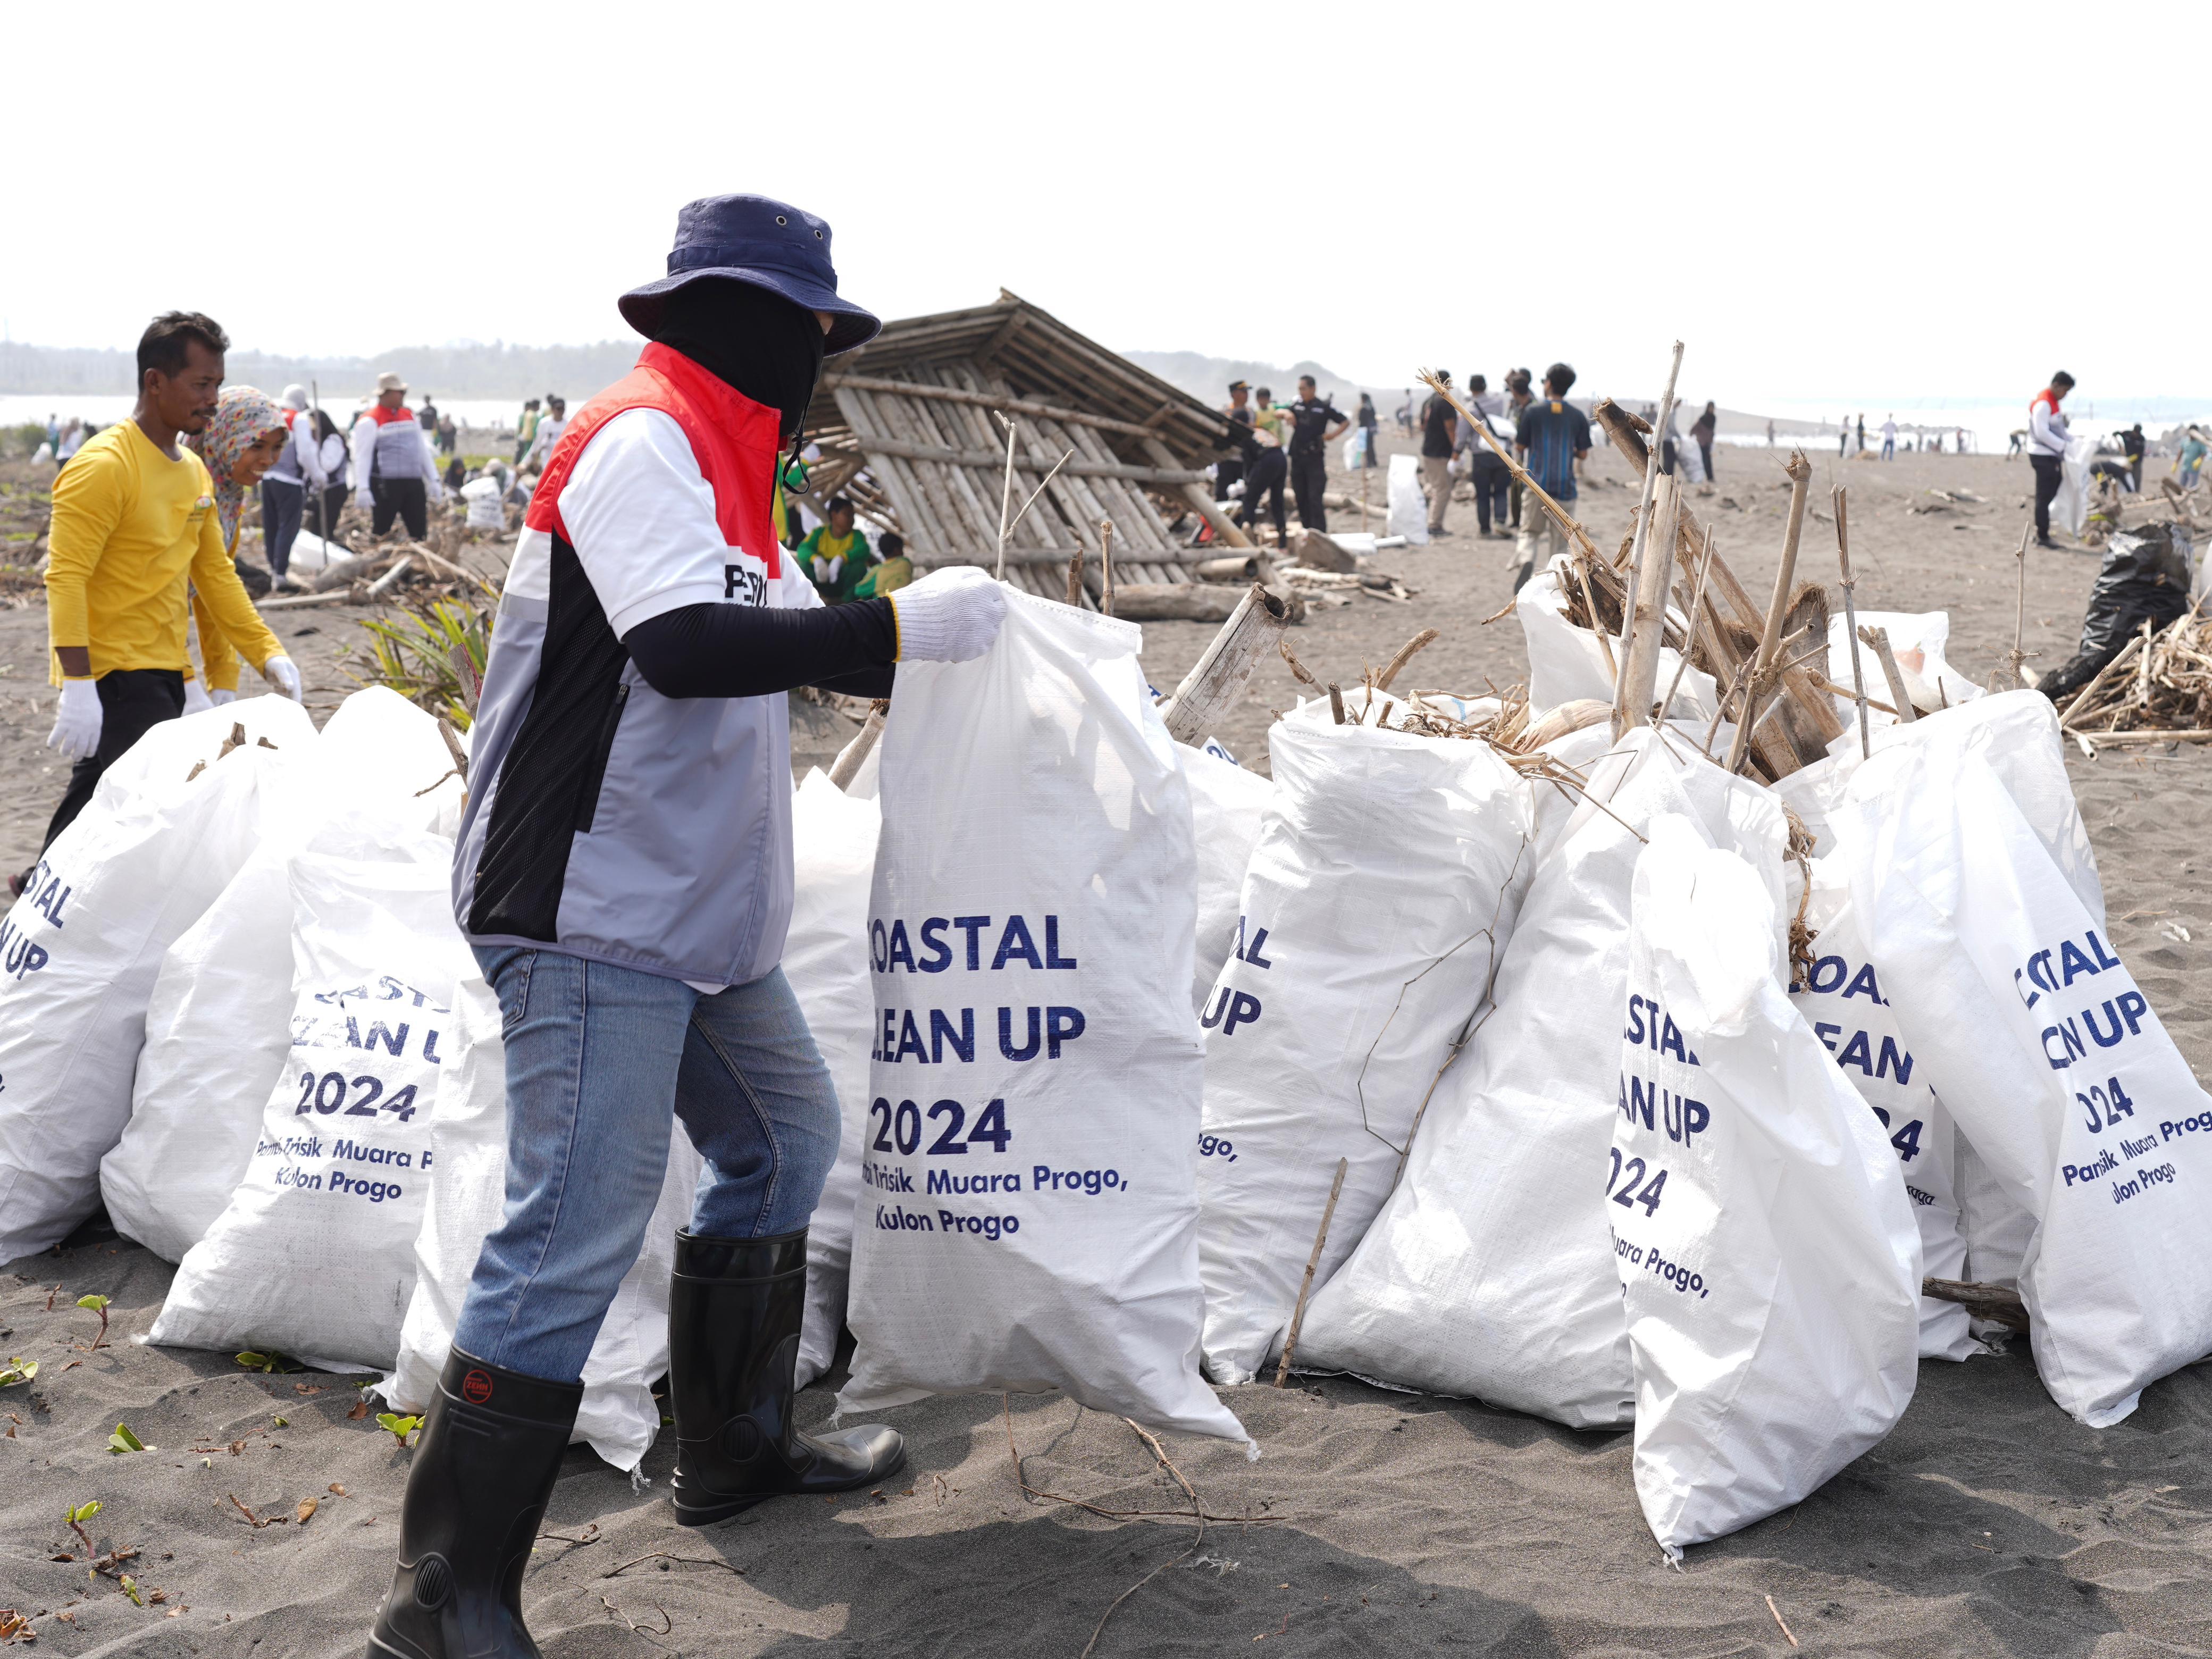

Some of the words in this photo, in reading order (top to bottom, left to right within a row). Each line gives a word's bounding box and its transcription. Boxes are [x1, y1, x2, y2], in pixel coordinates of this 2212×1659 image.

[6, 932, 48, 981] UP
[867, 915, 1077, 974] OASTAL
[872, 1007, 975, 1064] LEAN
[998, 1006, 1086, 1062] UP
[1201, 984, 1262, 1036] UP
[1624, 993, 1701, 1066] STA
[2081, 991, 2147, 1048] UP
[295, 1071, 418, 1122] 2024
[1663, 1088, 1710, 1148] UP
[870, 1096, 1011, 1156] 2024
[2119, 1134, 2159, 1161] Muara
[283, 1136, 323, 1158] Trisik
[332, 1139, 412, 1168] Muara
[2137, 1162, 2176, 1189] Progo
[274, 1166, 322, 1190] Kulon
[328, 1170, 403, 1203] Progo
[873, 1163, 916, 1193] Trisik
[927, 1169, 1021, 1195] Muara
[1033, 1164, 1128, 1196] Progo,
[876, 1204, 934, 1232] Kulon
[937, 1210, 1019, 1242] Progo
[1644, 1247, 1710, 1299] Progo,
